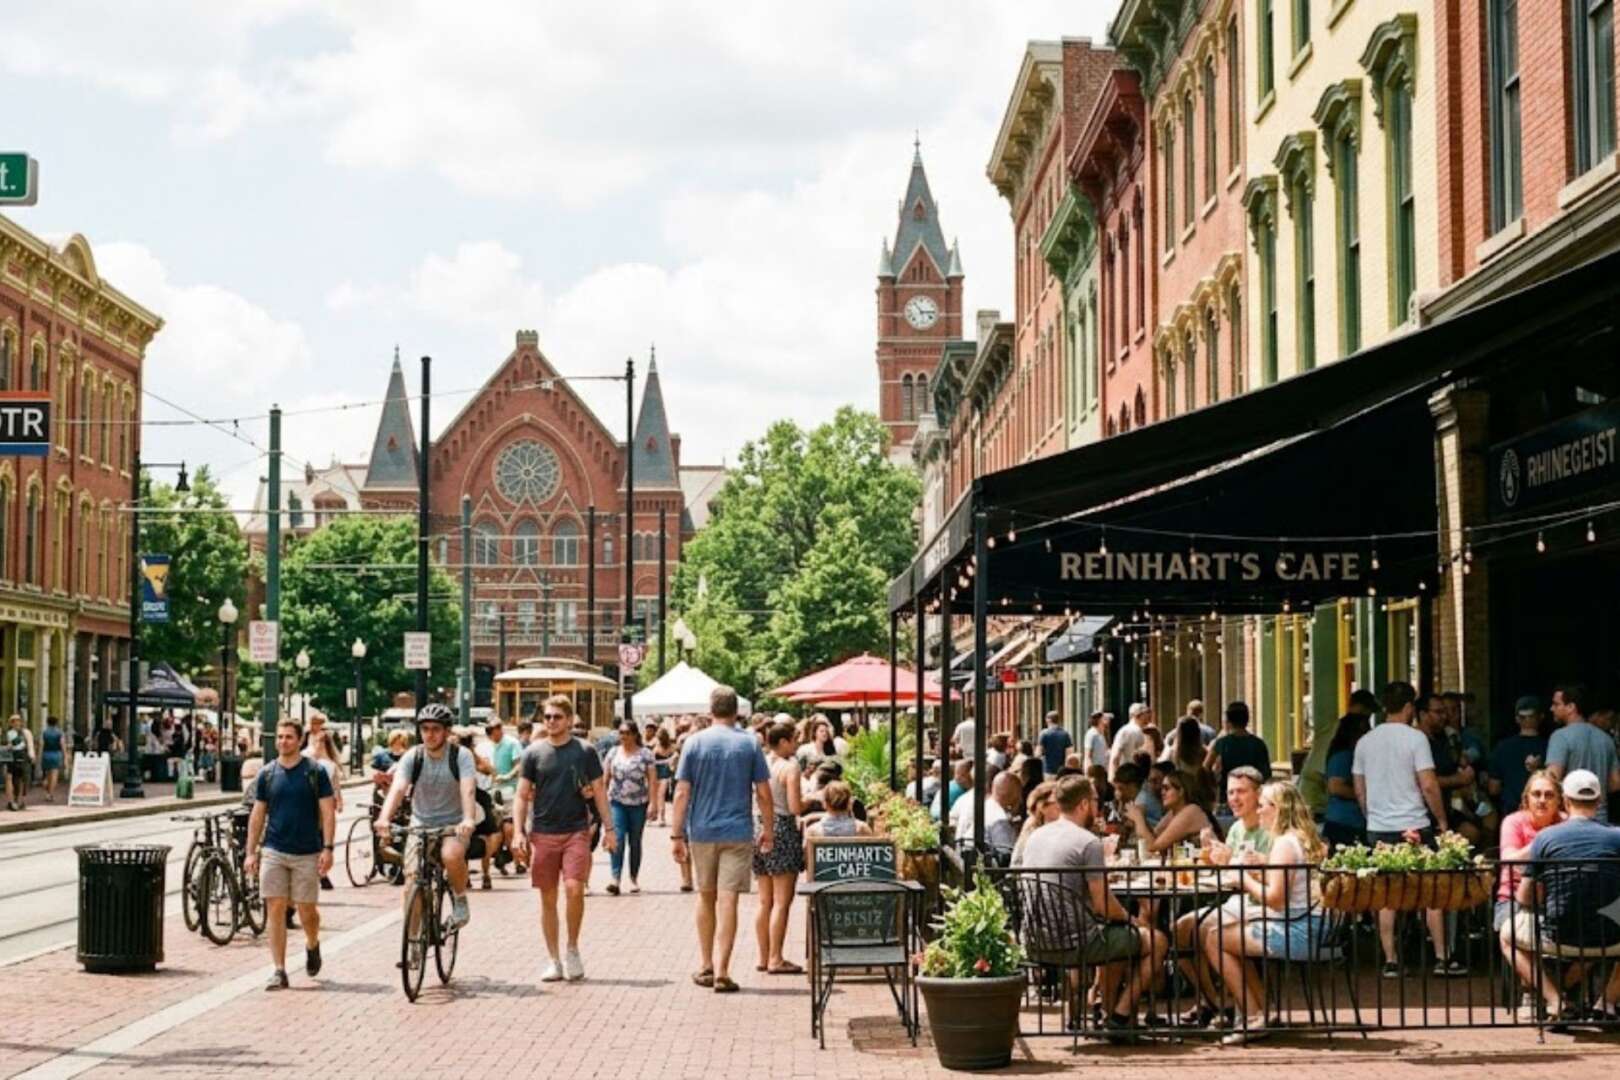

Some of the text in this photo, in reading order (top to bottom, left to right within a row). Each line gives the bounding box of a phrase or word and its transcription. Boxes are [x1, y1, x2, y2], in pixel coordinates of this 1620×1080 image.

[0, 407, 44, 437] TR
[1526, 428, 1616, 488] RHINEGEIST
[1060, 551, 1360, 581] REINHART'S CAFE
[815, 846, 894, 863] REINHART'S
[837, 863, 872, 878] CAFE
